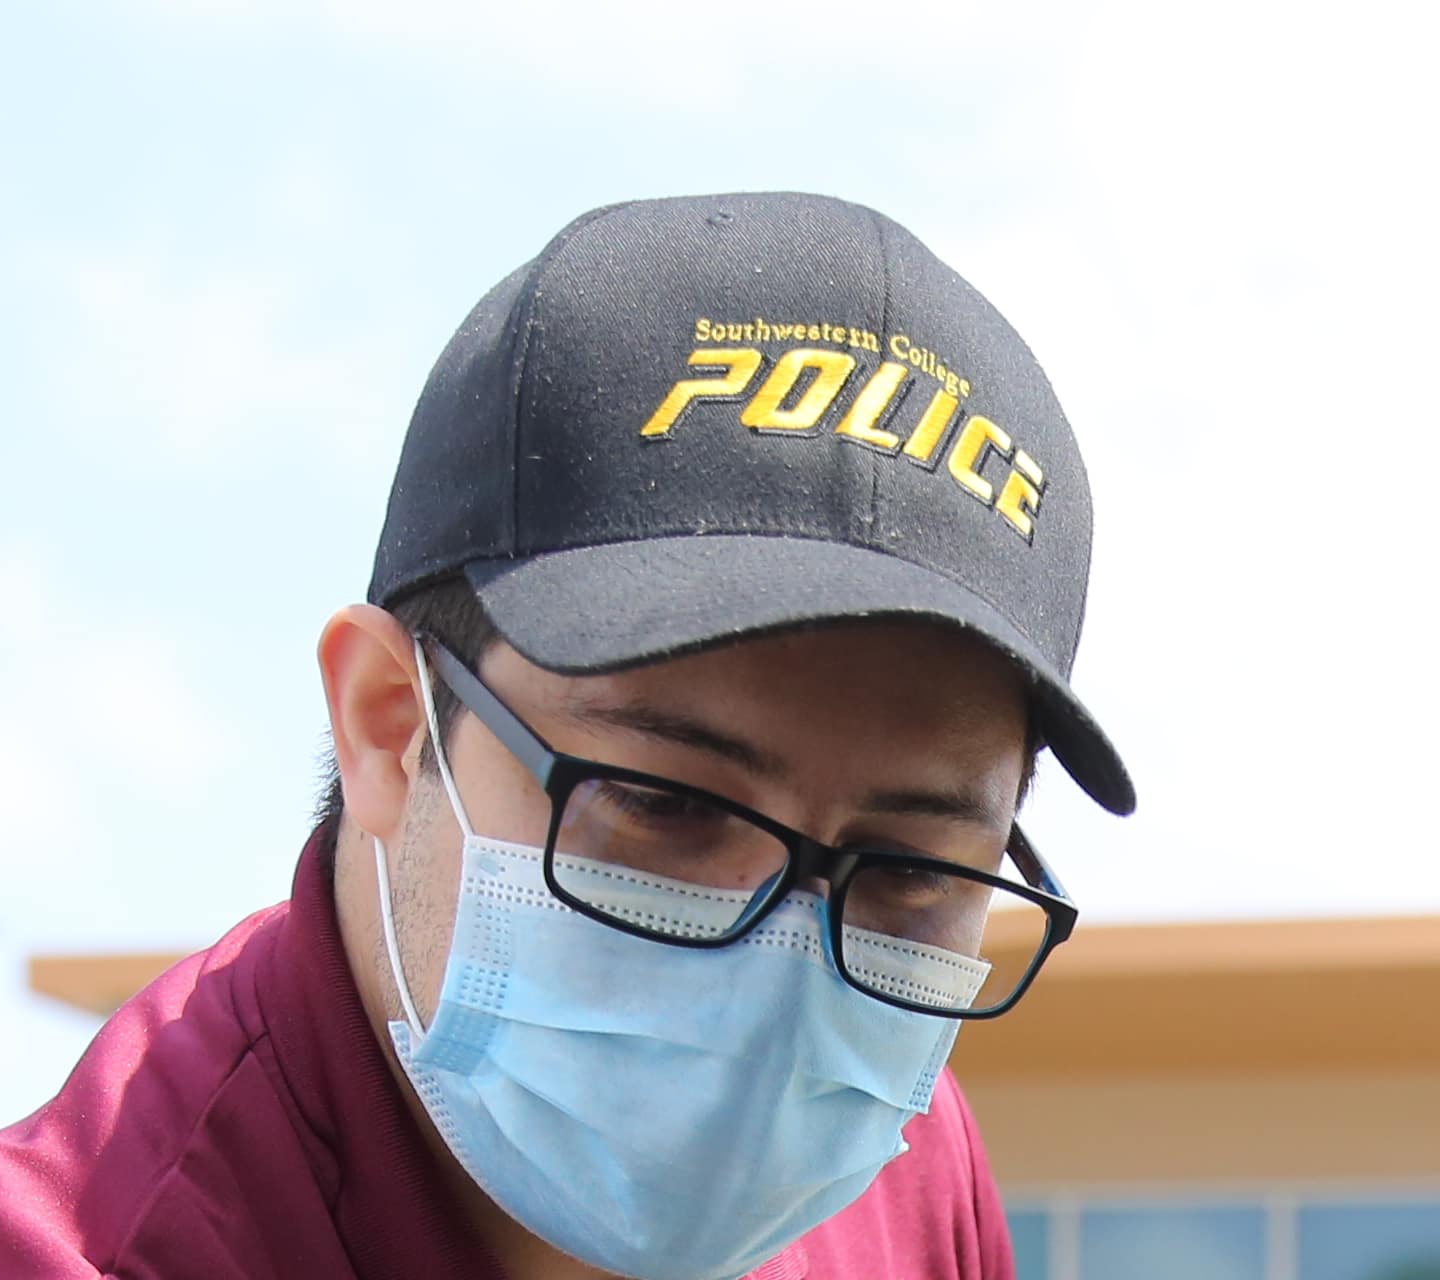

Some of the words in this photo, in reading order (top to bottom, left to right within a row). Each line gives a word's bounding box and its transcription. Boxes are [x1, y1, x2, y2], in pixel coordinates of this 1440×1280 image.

[694, 317, 880, 353] Southwestern
[889, 334, 972, 398] College
[639, 346, 1046, 542] POLICE
